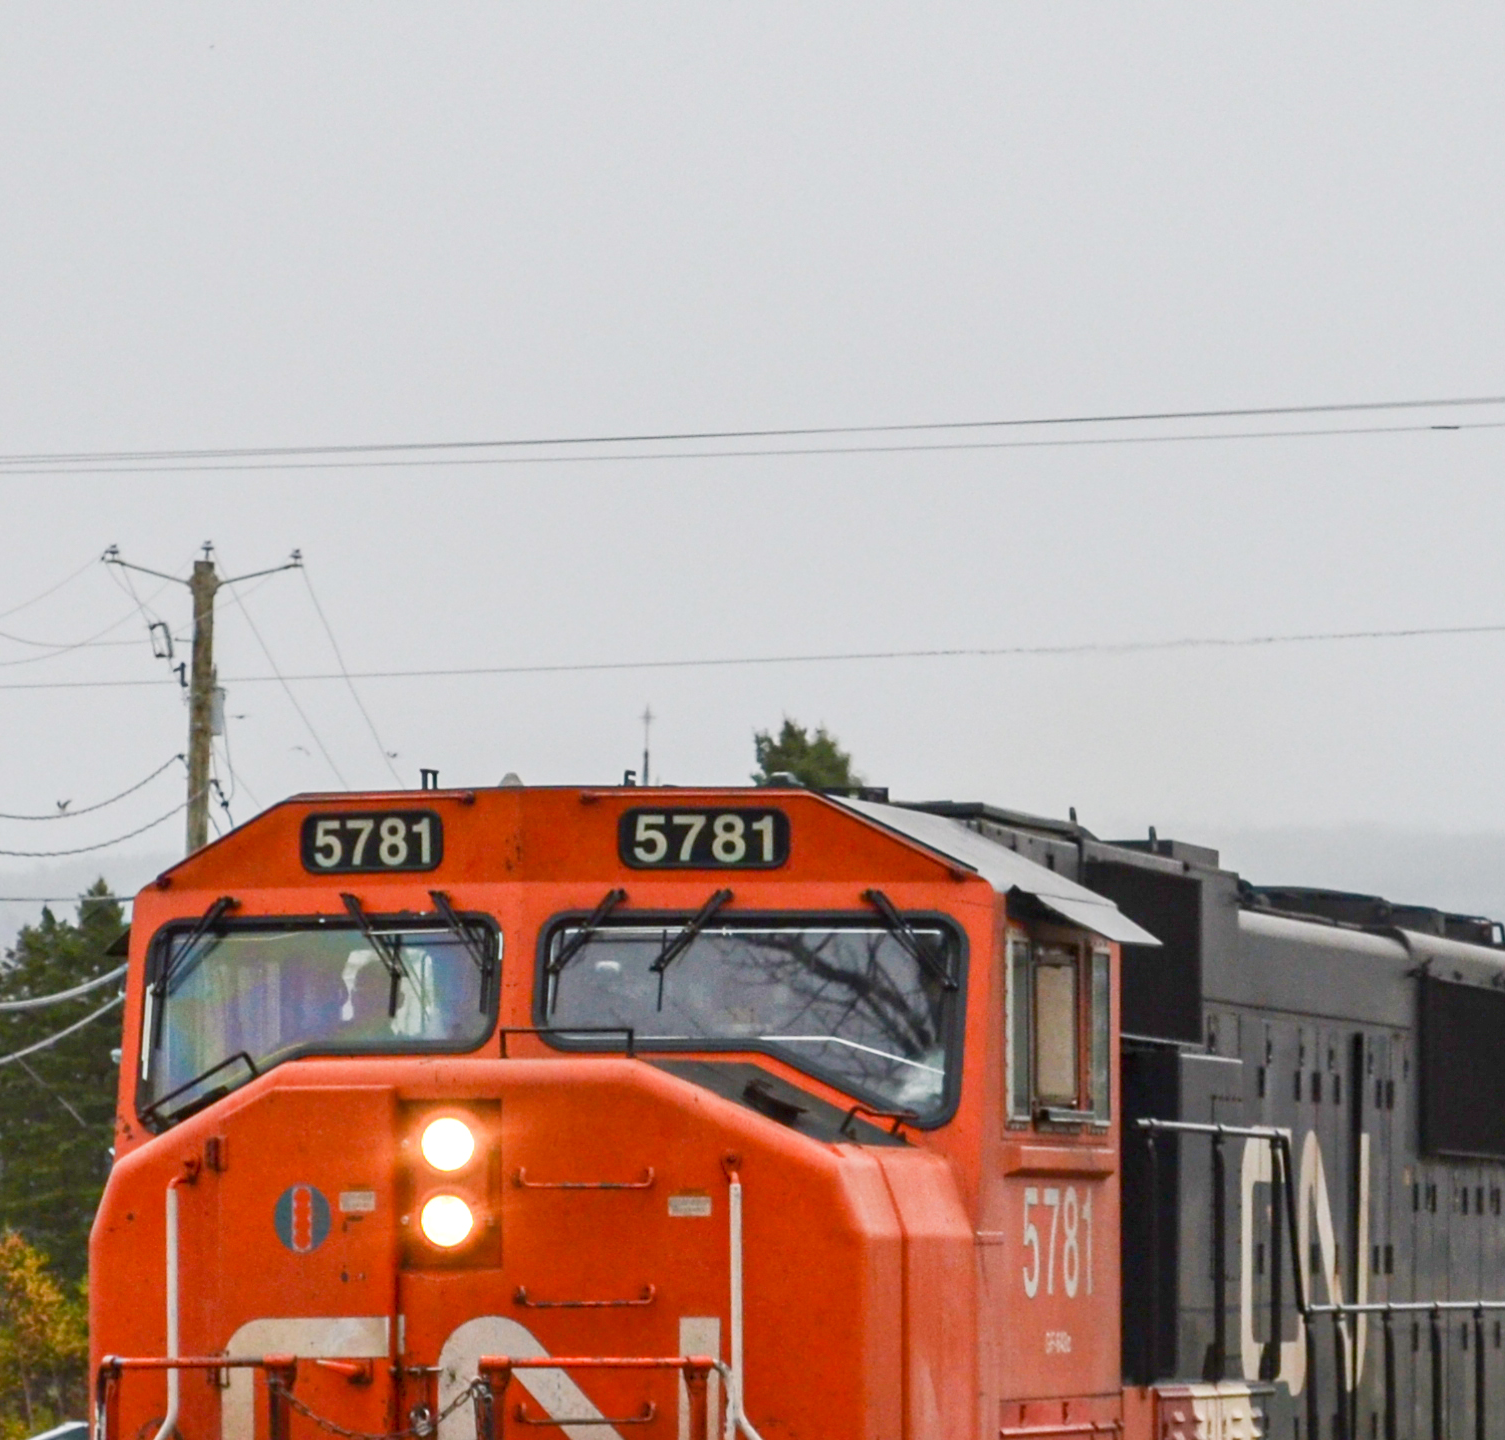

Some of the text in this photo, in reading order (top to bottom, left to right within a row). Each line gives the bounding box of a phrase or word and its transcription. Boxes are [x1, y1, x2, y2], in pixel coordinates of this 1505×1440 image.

[314, 817, 432, 868] 5781
[633, 813, 777, 864] 5781
[1022, 1186, 1094, 1299] 5781
[1241, 1126, 1370, 1398] CN
